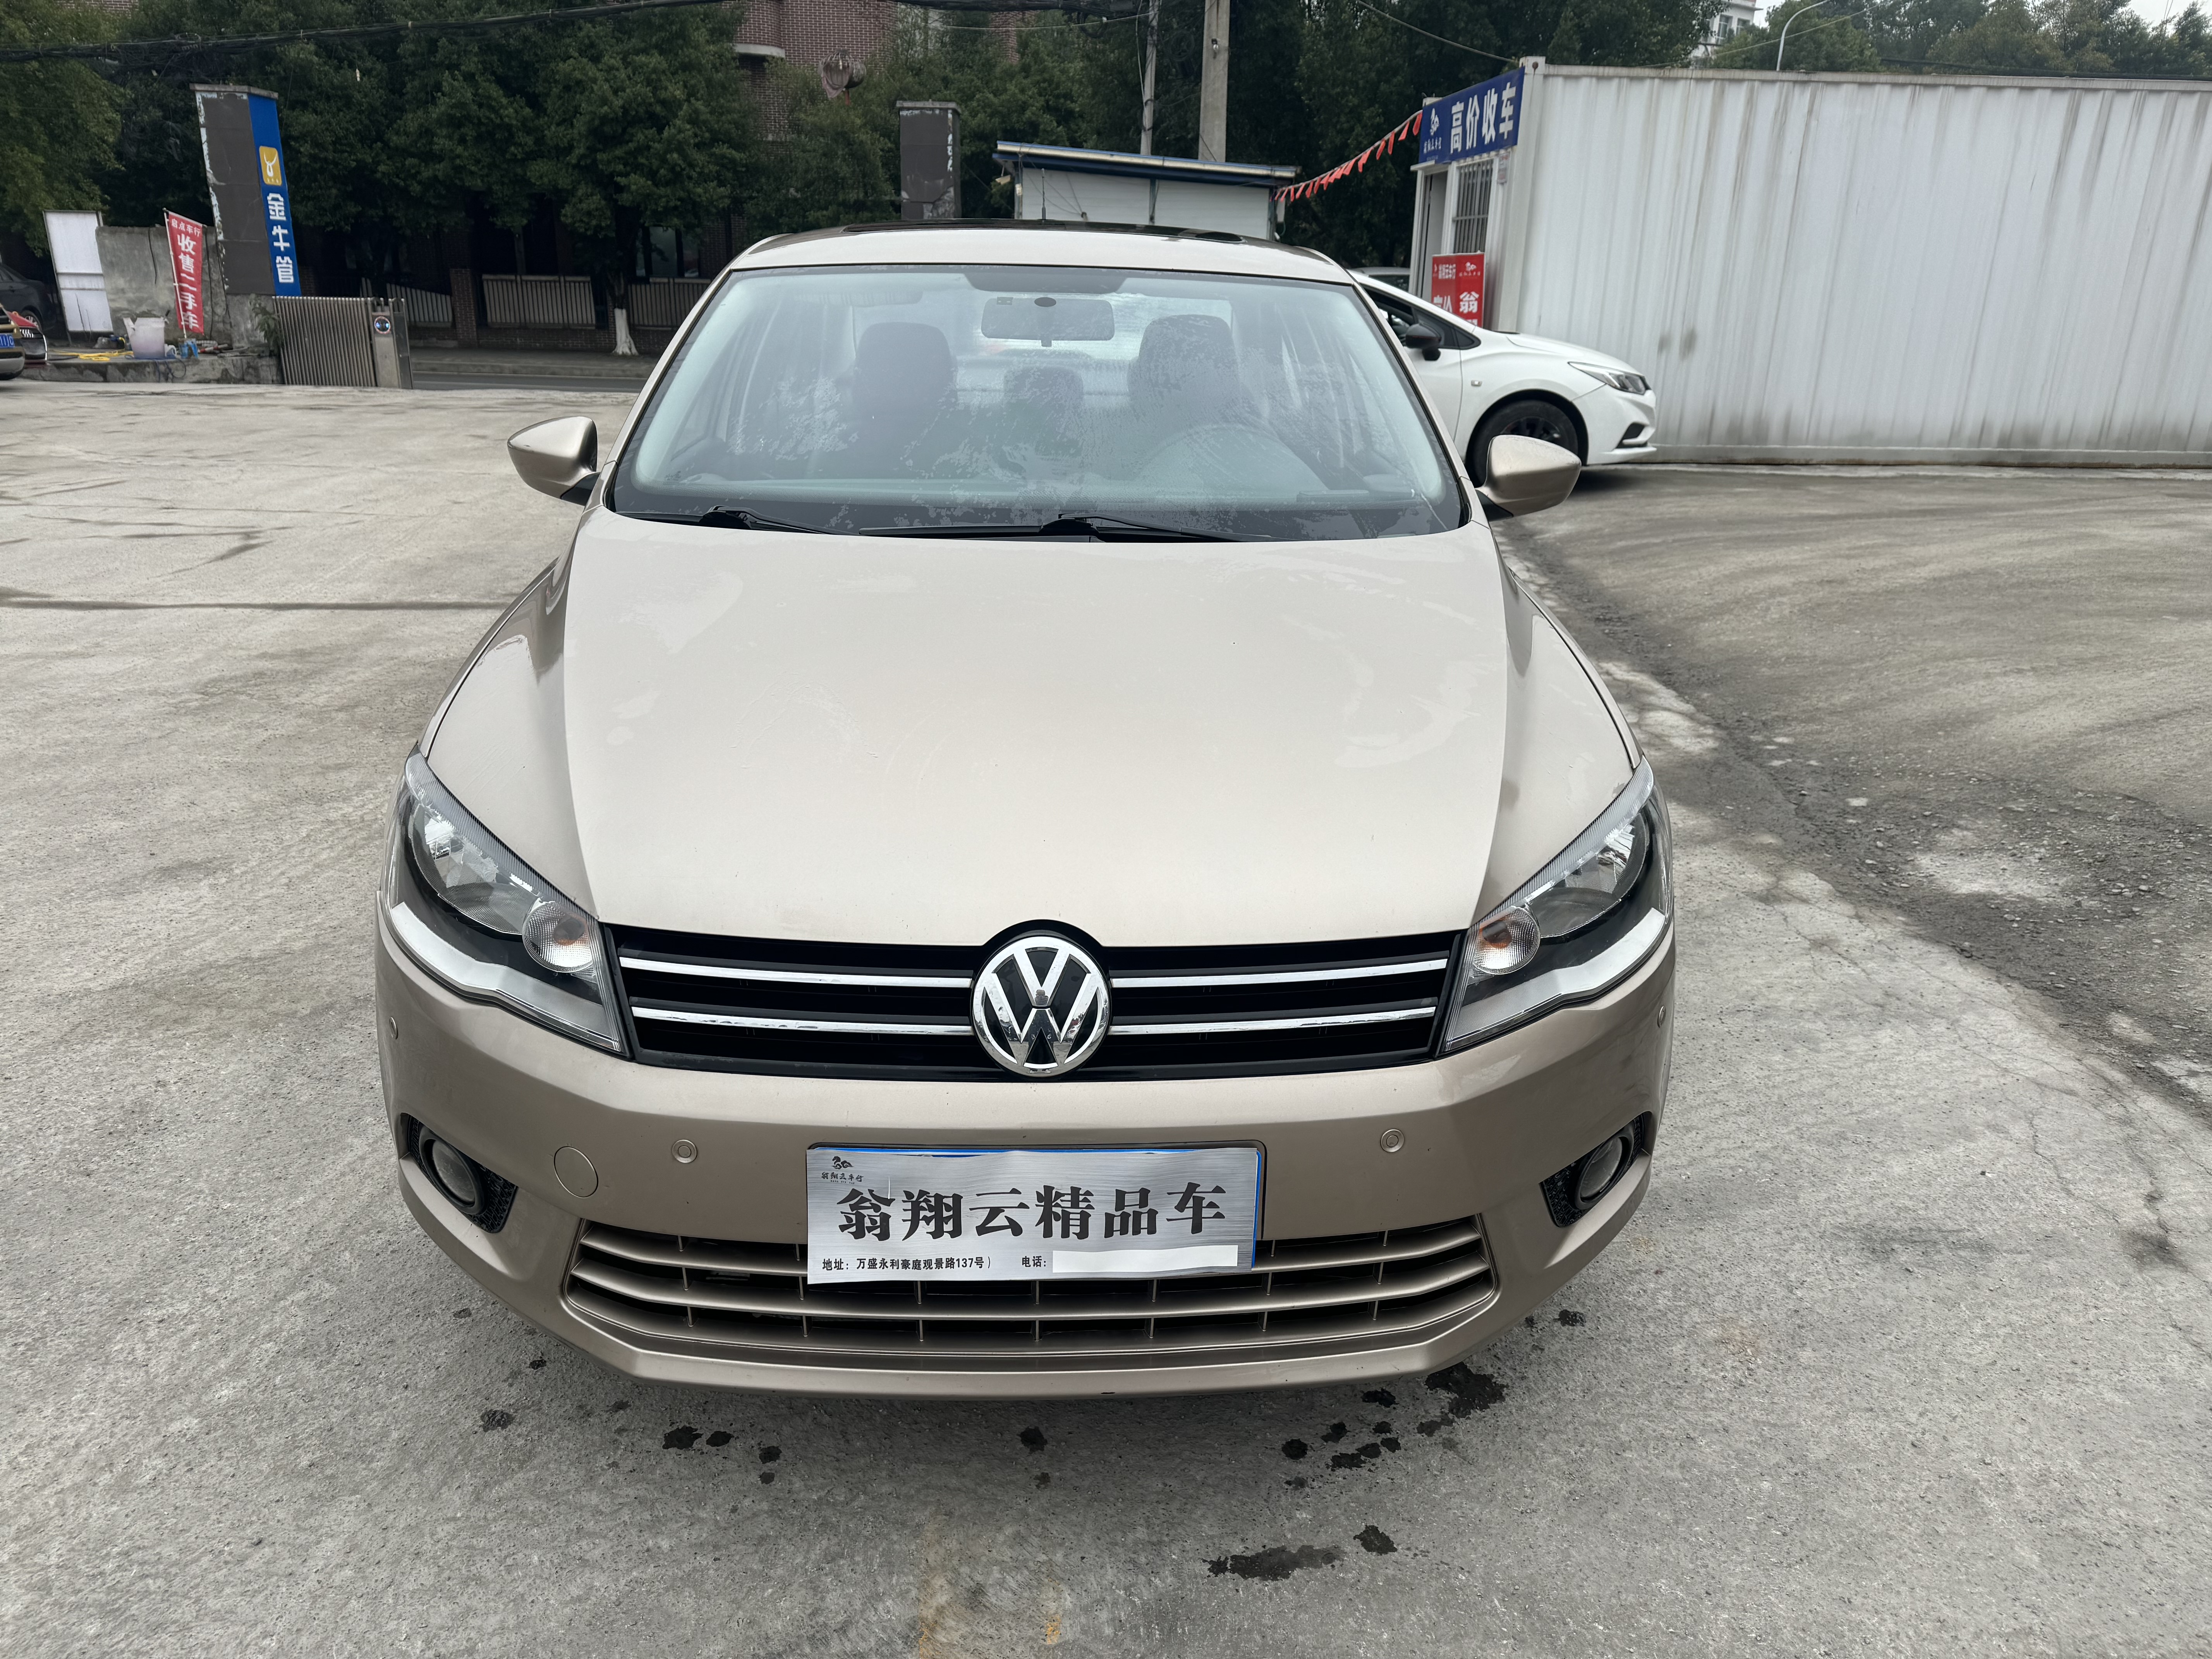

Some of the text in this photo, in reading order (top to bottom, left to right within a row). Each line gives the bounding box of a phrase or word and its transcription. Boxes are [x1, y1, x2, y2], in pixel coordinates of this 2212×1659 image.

[1450, 82, 1516, 154] 高价收车
[267, 193, 294, 283] 金牛管
[177, 233, 199, 329] 收售二手车
[1460, 291, 1479, 326] 翁
[837, 1182, 1226, 1242] 翁翔云精品车
